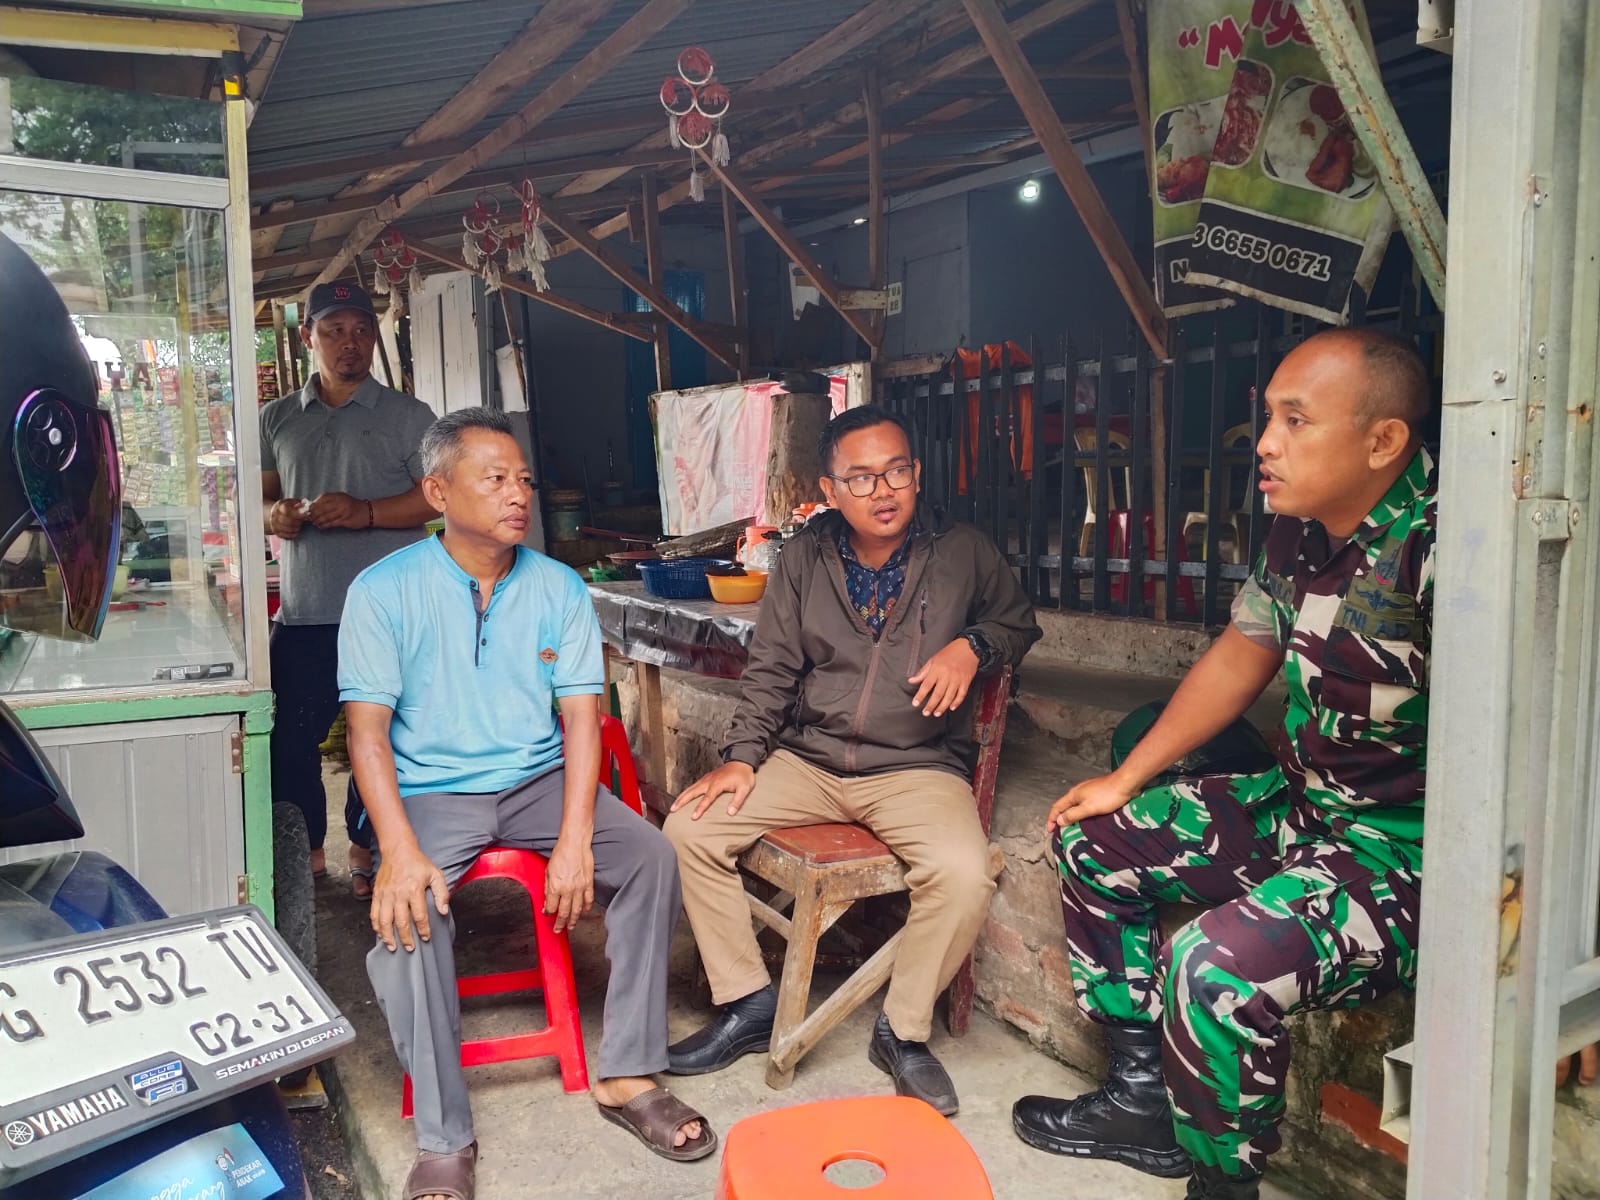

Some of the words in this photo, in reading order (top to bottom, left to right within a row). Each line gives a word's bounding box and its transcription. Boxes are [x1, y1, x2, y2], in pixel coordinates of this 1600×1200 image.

[1208, 226, 1271, 263] 6655
[1269, 244, 1331, 281] 0671
[54, 946, 207, 1025] 2532
[206, 926, 280, 980] TV
[302, 1026, 345, 1048] DEPAN
[28, 1087, 127, 1137] YAMAHA
